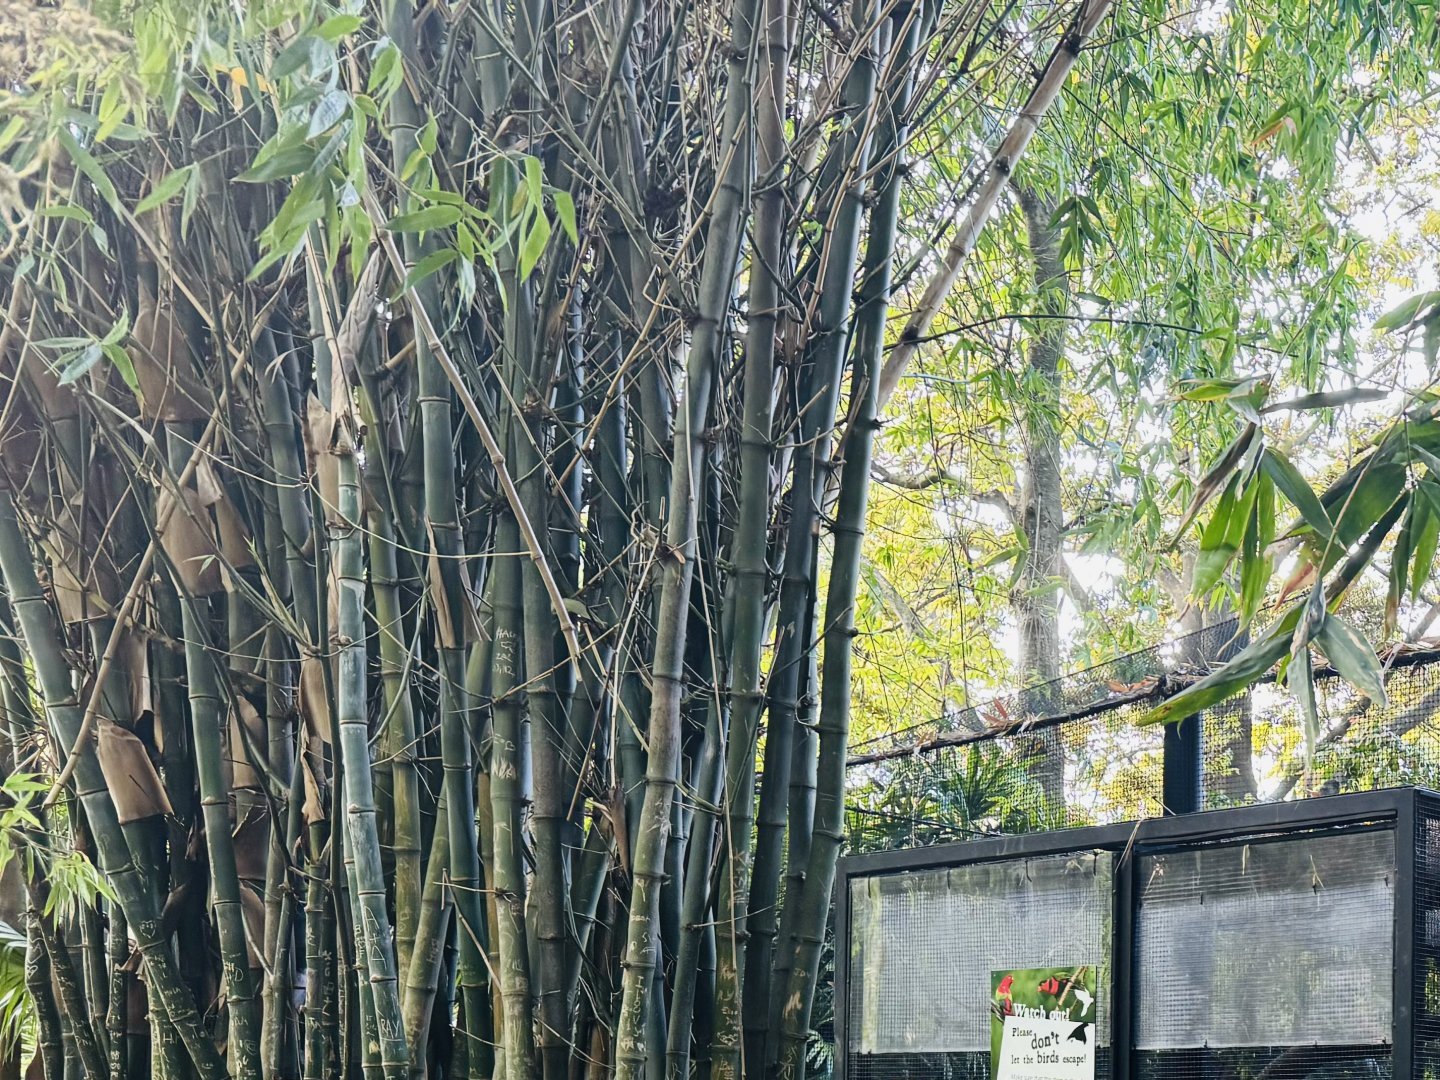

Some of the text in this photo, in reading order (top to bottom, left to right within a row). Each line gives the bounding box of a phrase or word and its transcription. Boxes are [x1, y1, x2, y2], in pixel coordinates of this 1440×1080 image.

[1012, 1003, 1046, 1019] Watch
[1012, 1027, 1033, 1037] Please
[1031, 1031, 1060, 1050] don't
[1011, 1050, 1087, 1067] let the birds escape!
